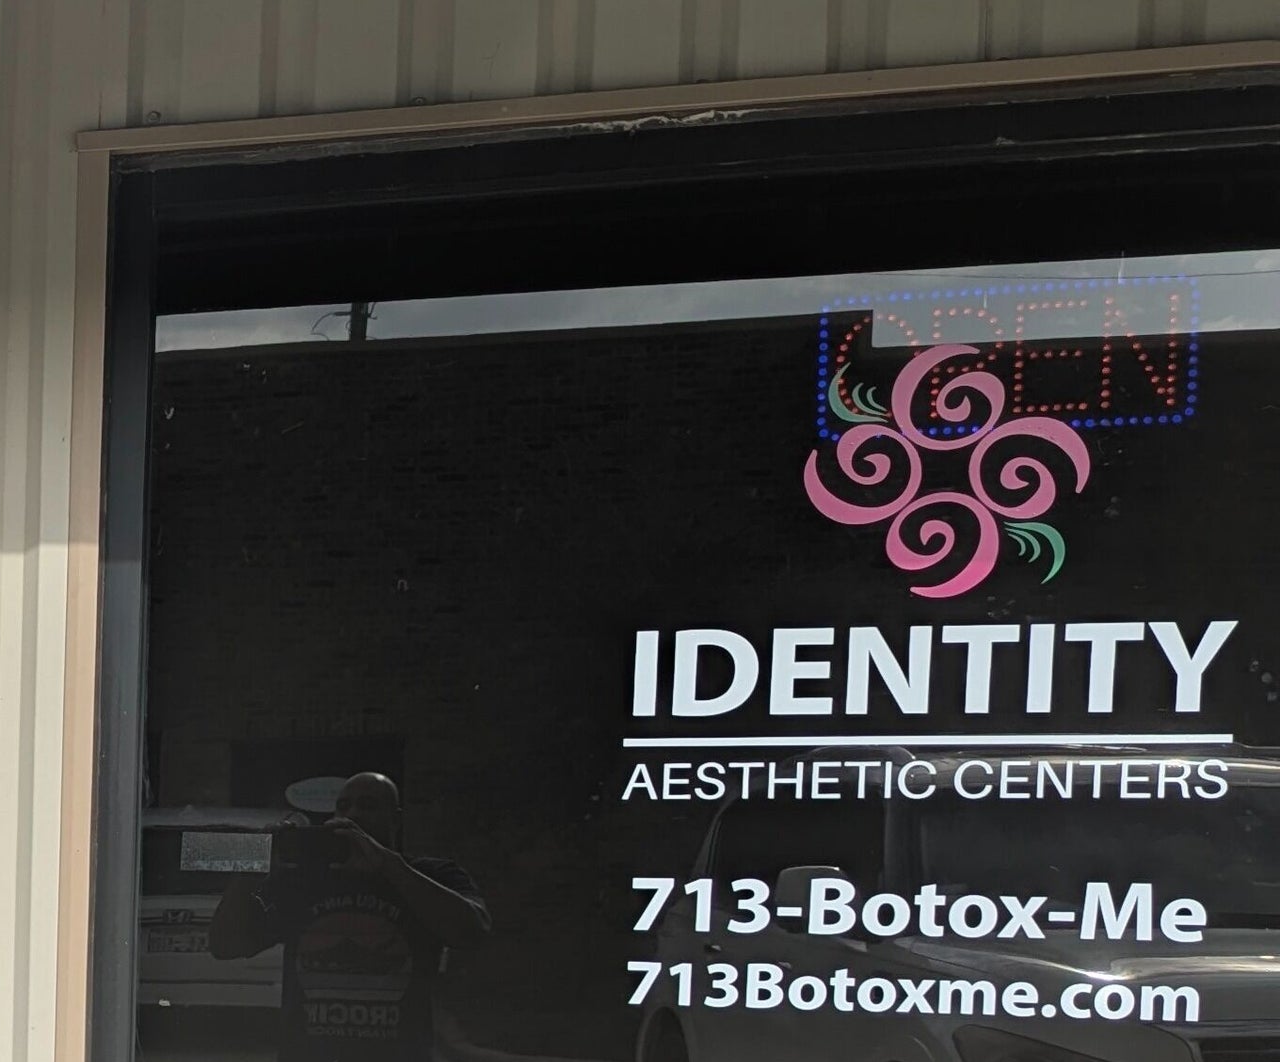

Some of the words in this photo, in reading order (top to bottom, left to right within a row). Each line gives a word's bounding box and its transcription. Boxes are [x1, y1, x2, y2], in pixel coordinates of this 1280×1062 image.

[836, 293, 1181, 418] OPEN
[632, 620, 1238, 717] IDENTITY
[621, 760, 937, 800] AESTHETIC
[953, 758, 1230, 800] CENTERS
[632, 877, 1207, 943] 713-Botox-Me
[627, 960, 1201, 1022] 713Botoxme.com
